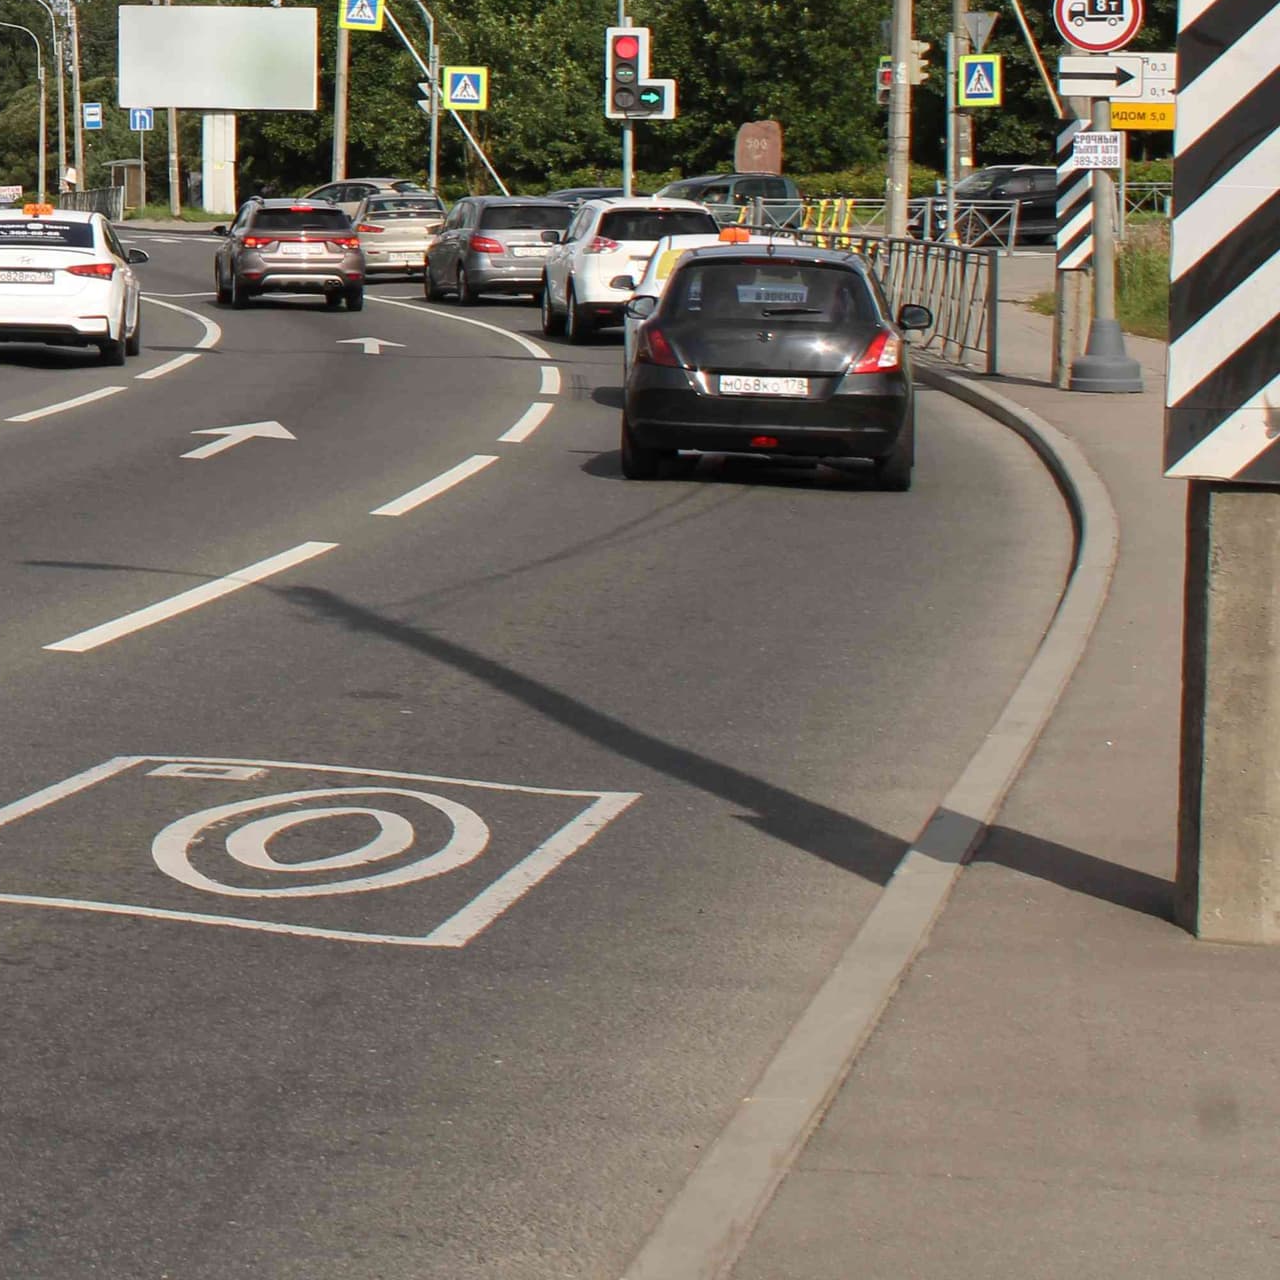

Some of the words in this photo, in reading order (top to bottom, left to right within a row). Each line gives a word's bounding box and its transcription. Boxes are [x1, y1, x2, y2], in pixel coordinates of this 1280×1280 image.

[1151, 63, 1167, 72] 0,3
[1150, 87, 1165, 97] 0,1
[1150, 111, 1166, 122] 5,0
[1073, 134, 1118, 144] СРОЧНЫЙ
